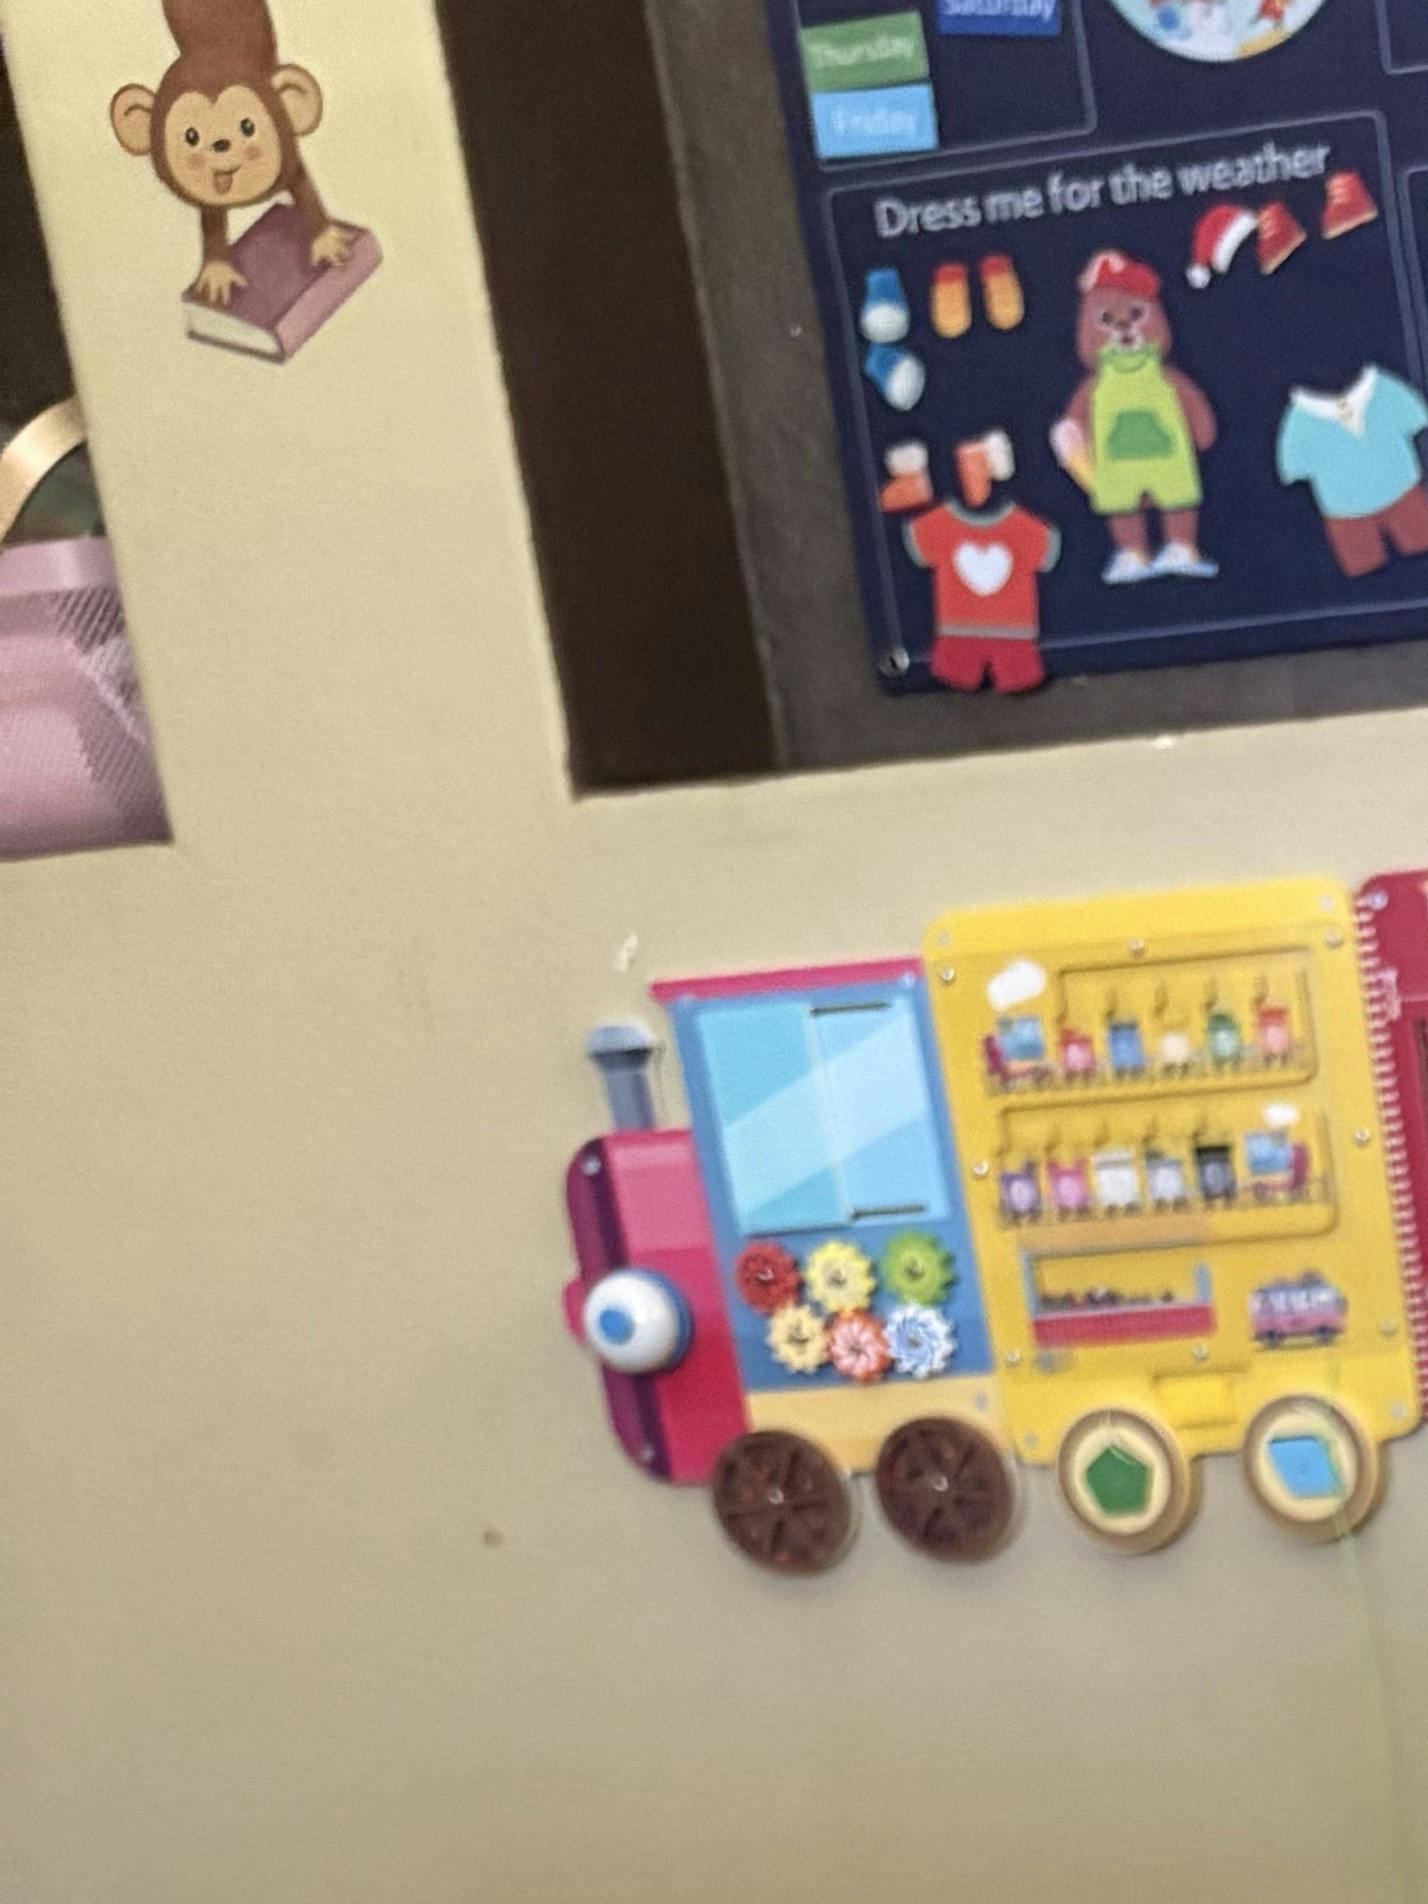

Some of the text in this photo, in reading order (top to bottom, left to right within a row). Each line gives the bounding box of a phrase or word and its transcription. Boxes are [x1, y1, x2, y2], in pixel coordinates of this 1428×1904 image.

[874, 142, 1330, 238] Dress me for the weather
